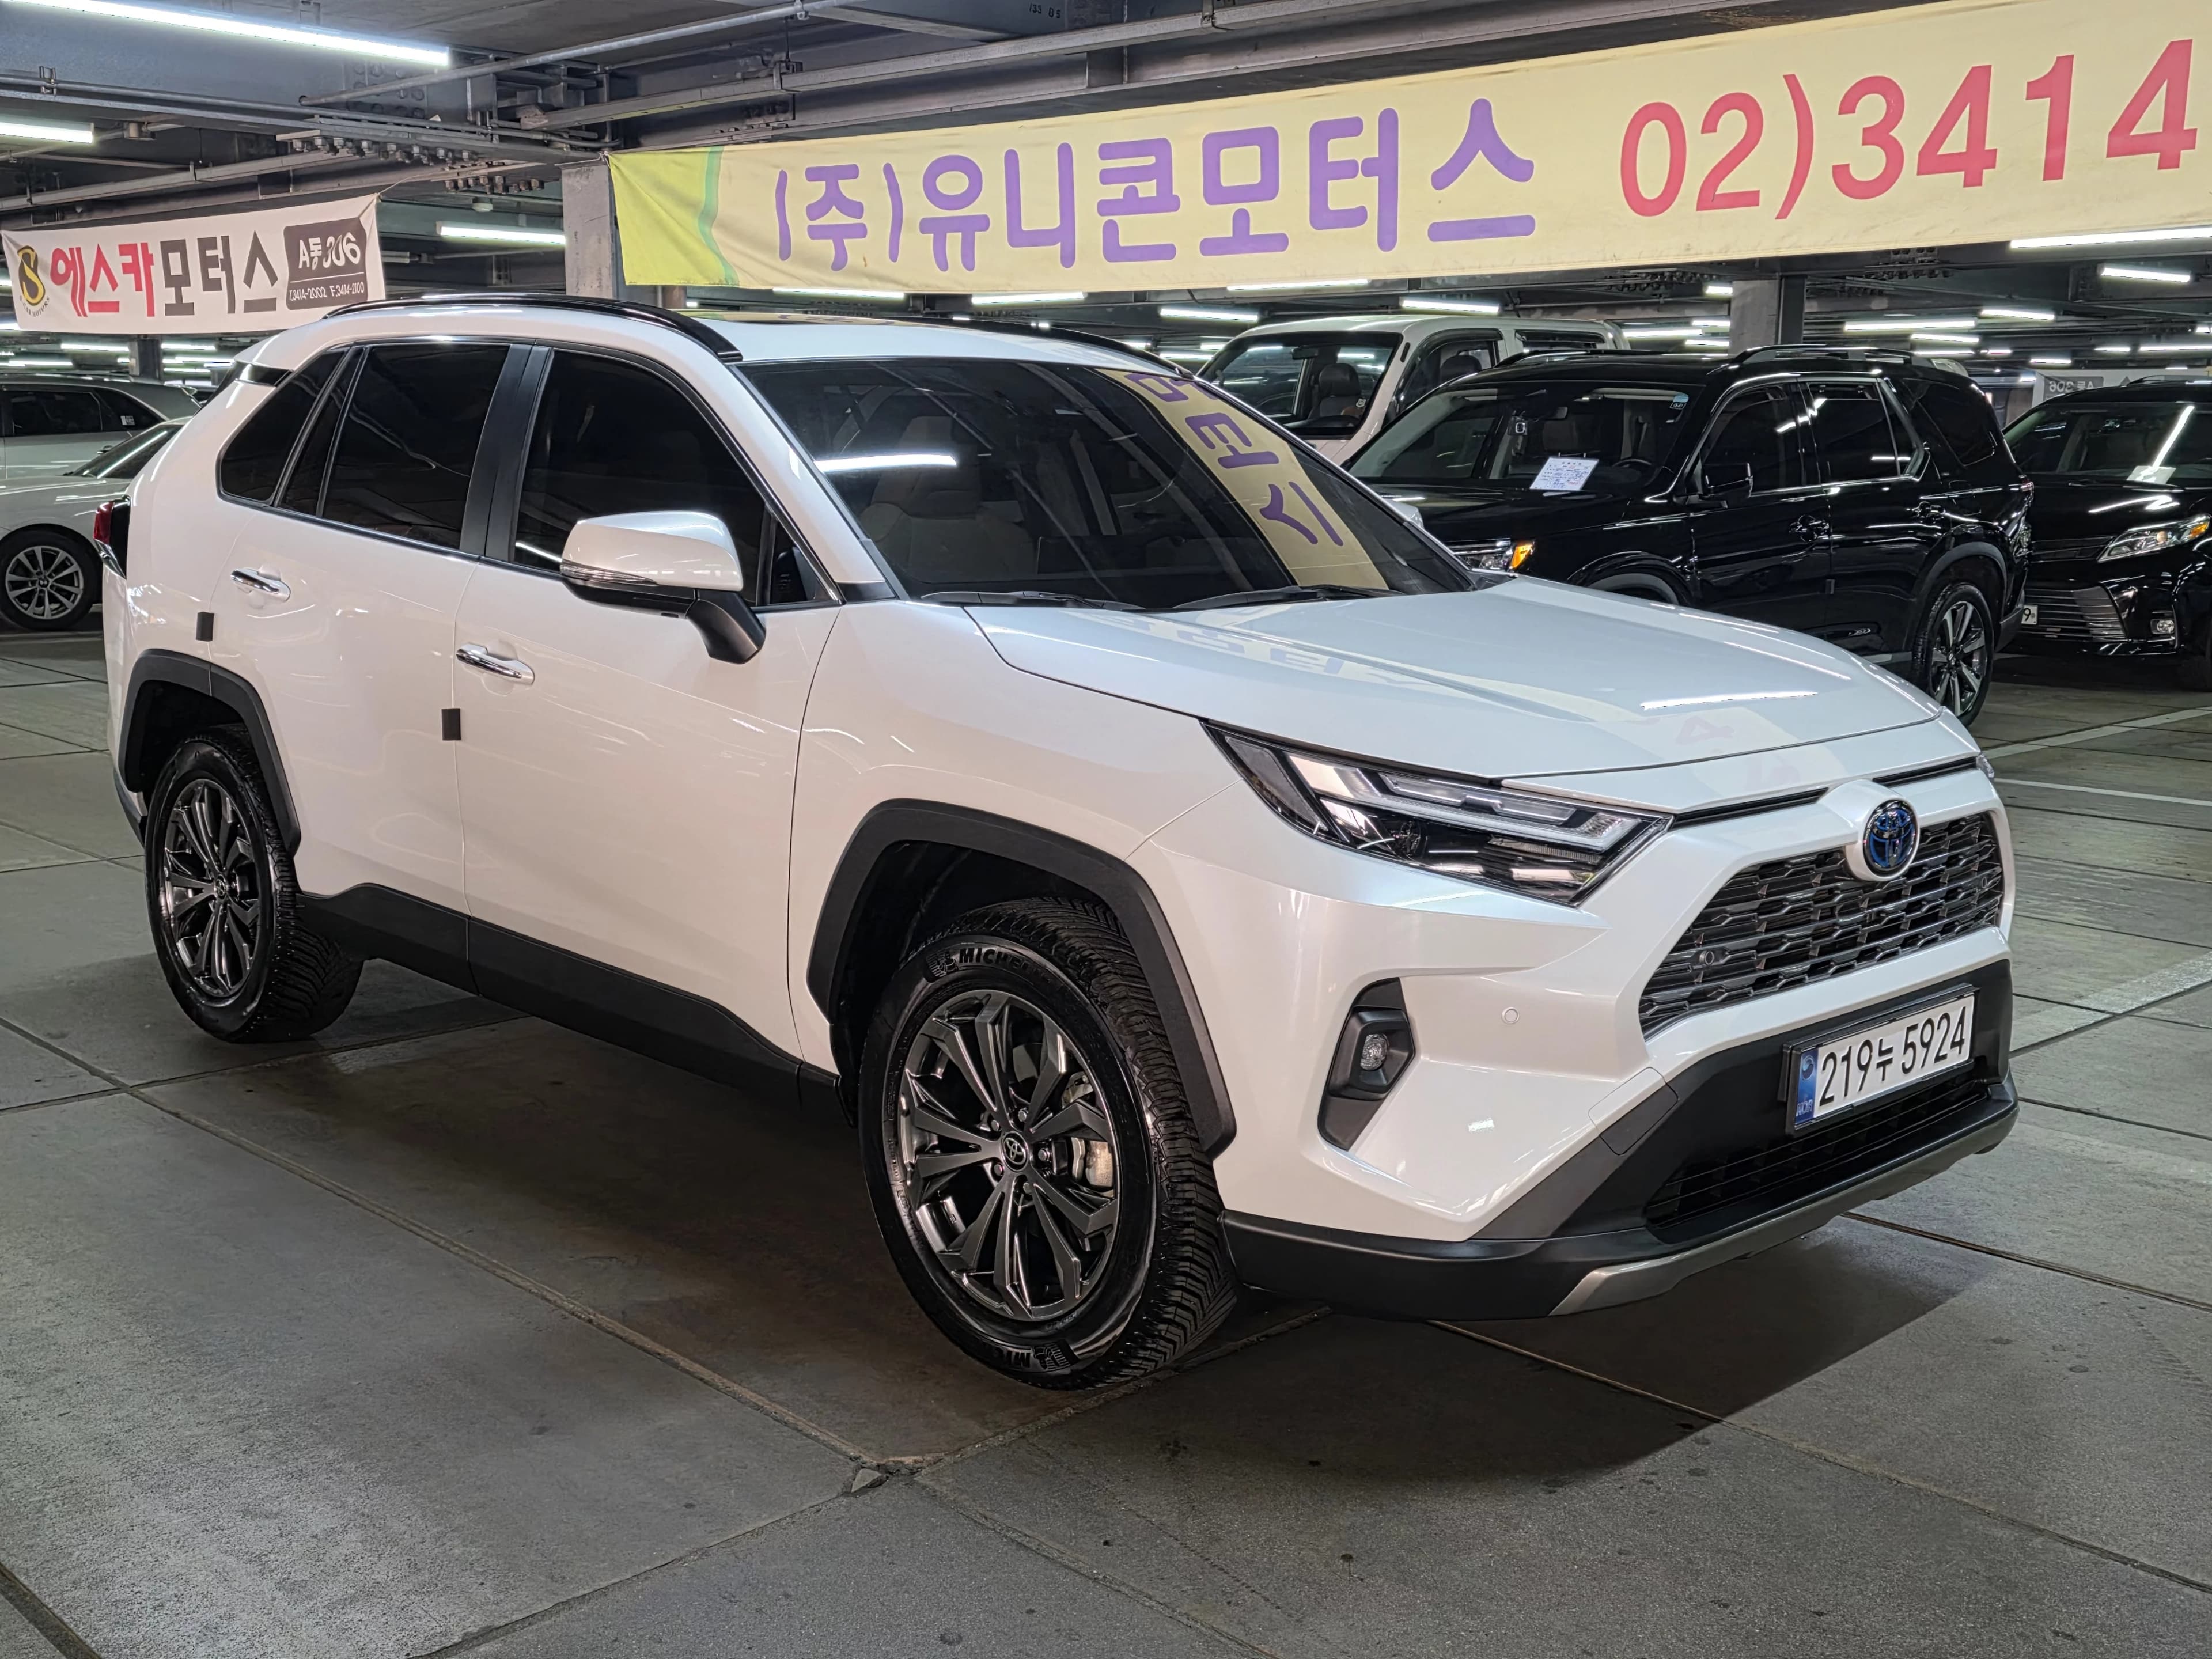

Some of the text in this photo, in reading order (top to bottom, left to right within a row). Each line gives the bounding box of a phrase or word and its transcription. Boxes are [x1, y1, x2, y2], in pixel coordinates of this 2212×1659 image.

[775, 98, 1536, 271] (주)유니콘모터스
[1620, 39, 2198, 219] 02)3414
[1819, 1006, 1966, 1107] 219누 5924
